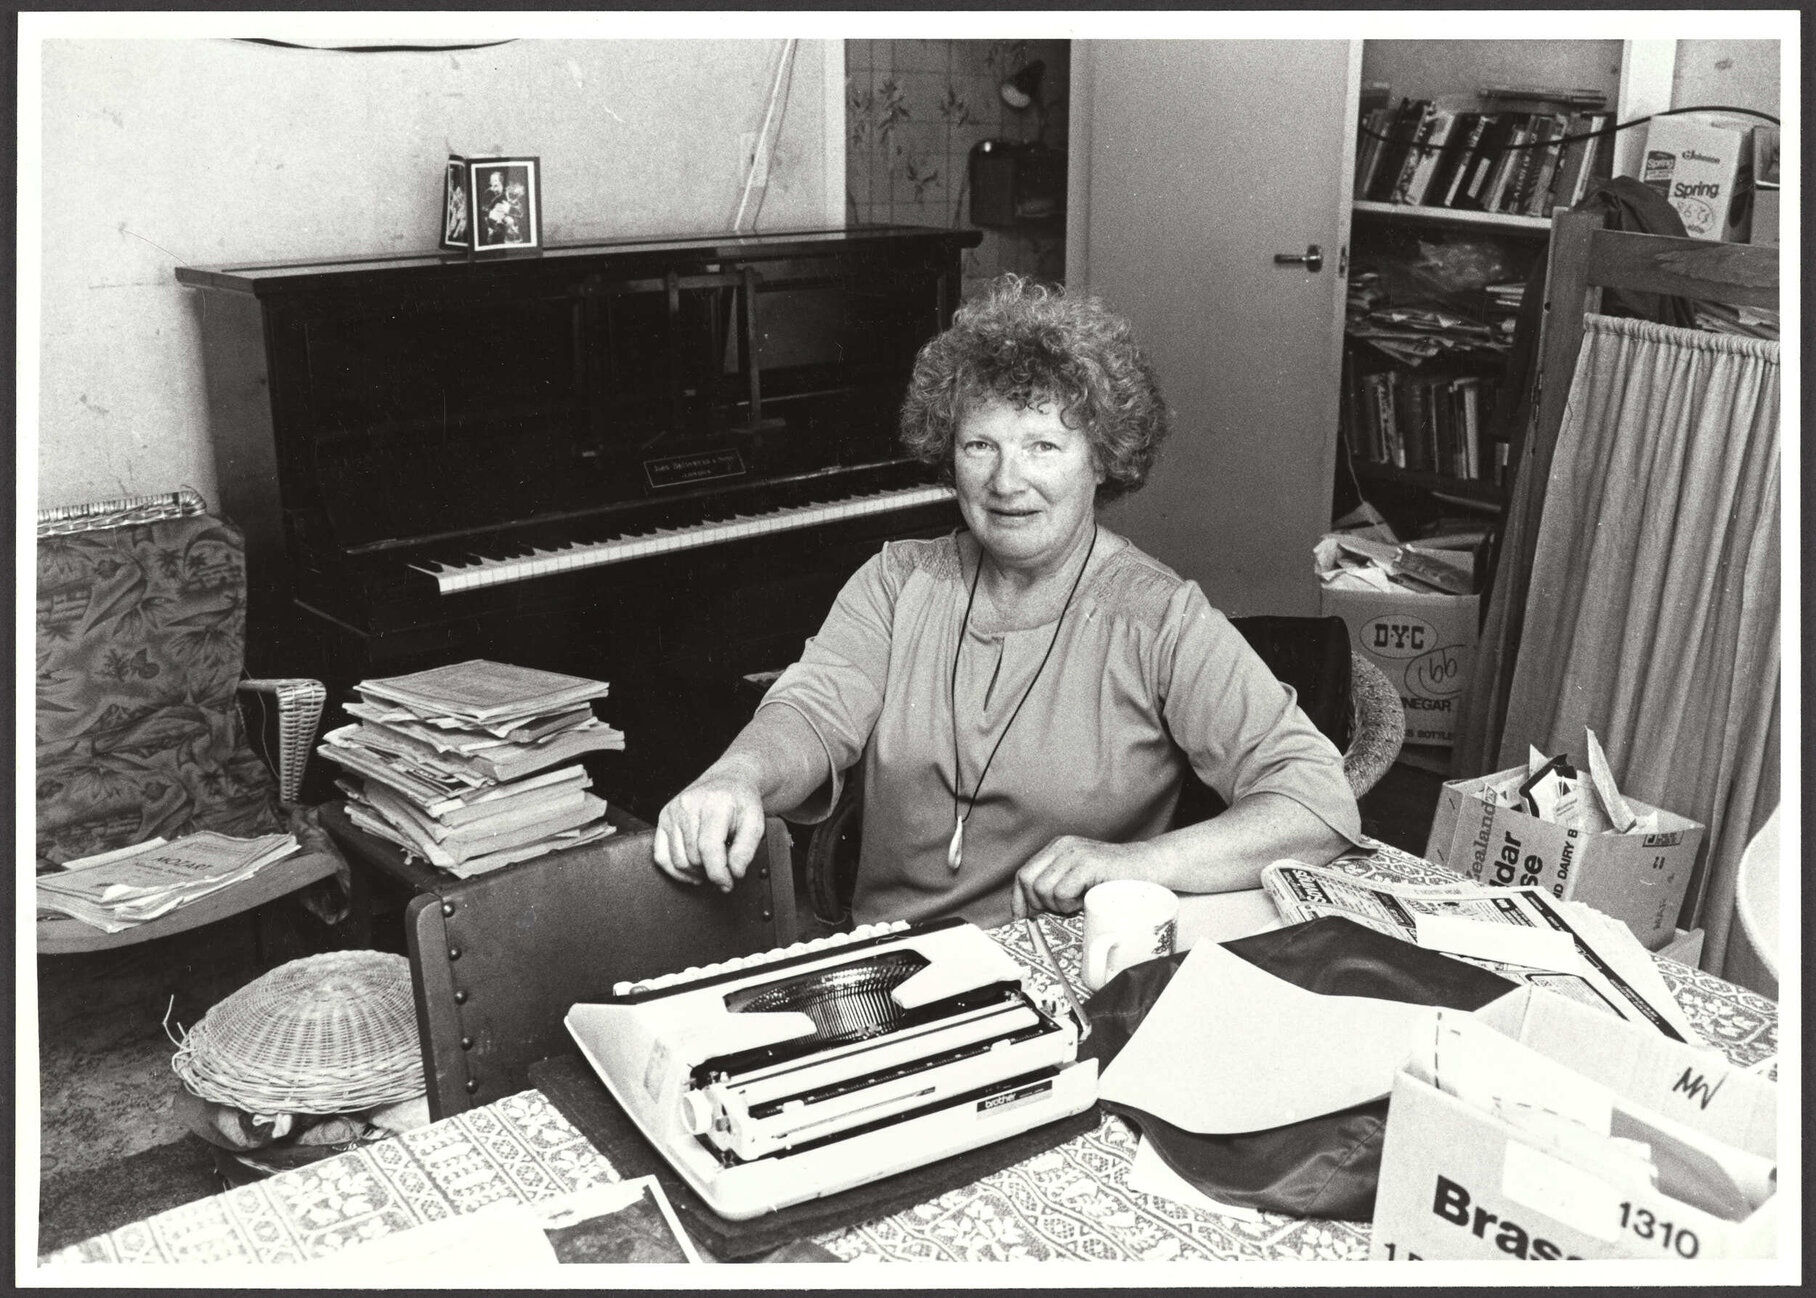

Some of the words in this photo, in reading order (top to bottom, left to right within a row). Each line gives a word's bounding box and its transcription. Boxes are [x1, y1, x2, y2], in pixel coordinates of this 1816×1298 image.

[1674, 181, 1720, 199] Spring
[1400, 697, 1452, 712] NEGAR
[1557, 841, 1575, 880] DAIRY
[984, 1092, 1017, 1109] brother
[1432, 1174, 1584, 1260] Bras
[1618, 1201, 1700, 1260] 1310
